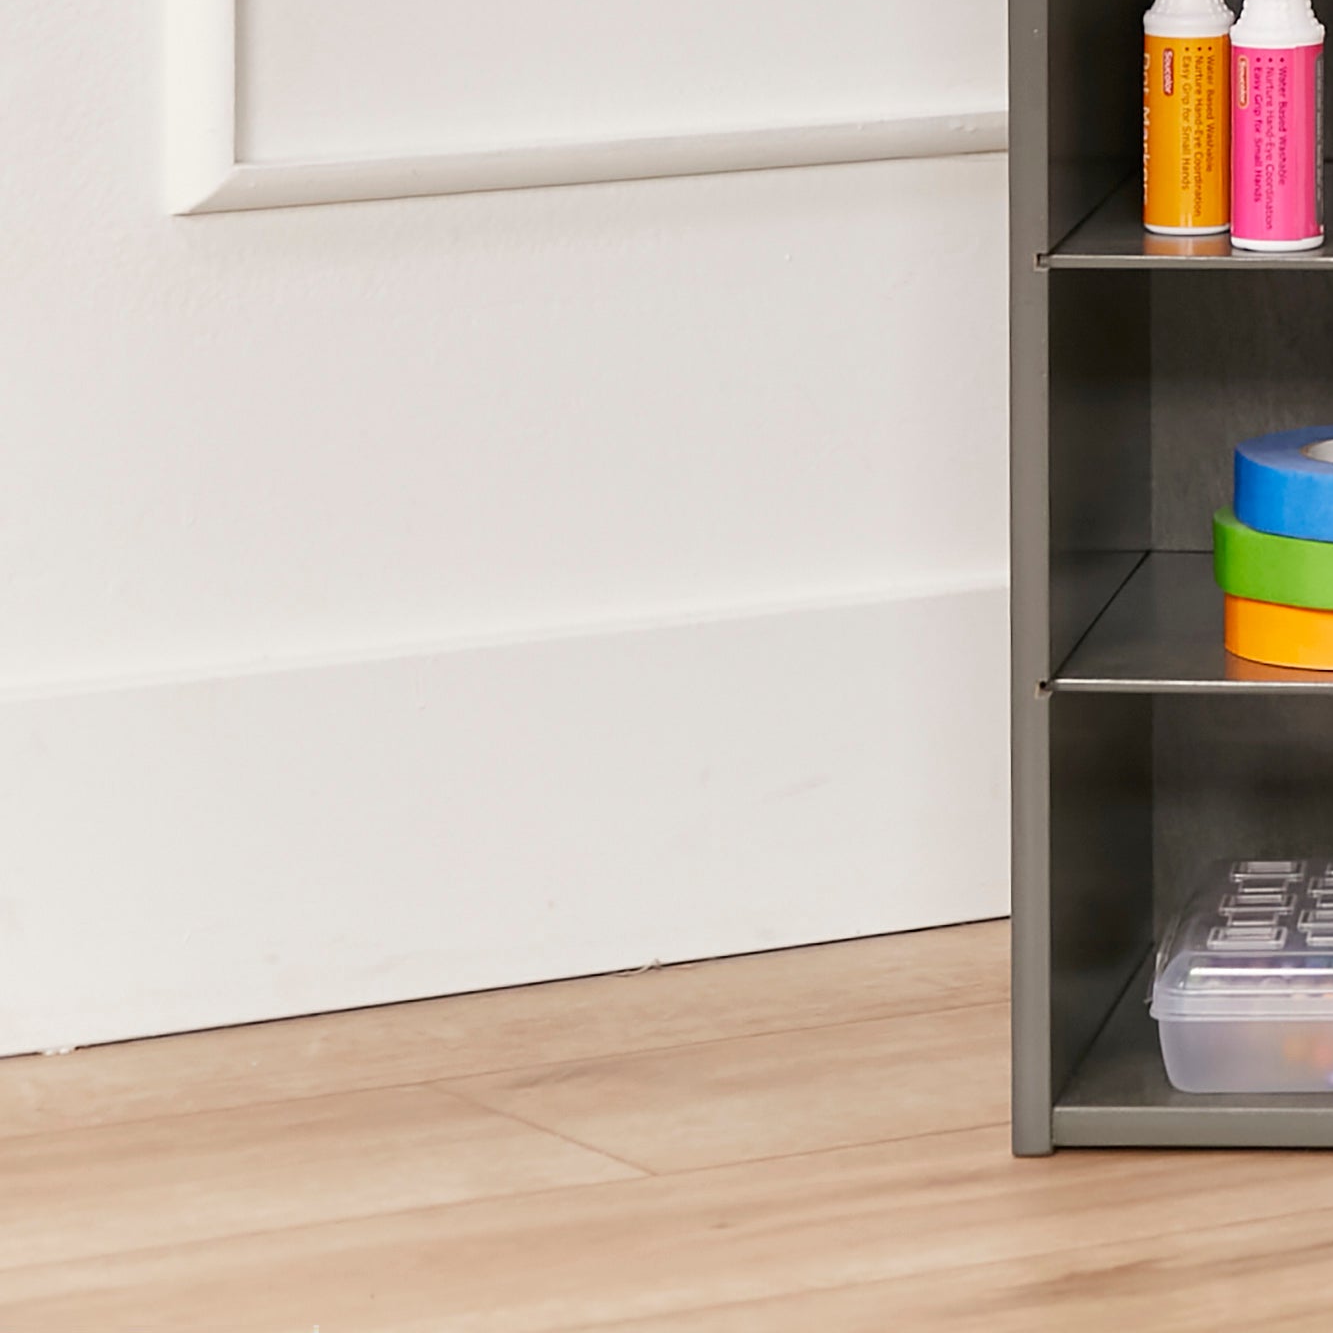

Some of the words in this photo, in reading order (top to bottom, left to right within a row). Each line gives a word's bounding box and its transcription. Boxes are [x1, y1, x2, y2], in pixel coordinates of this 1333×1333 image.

[1181, 56, 1192, 79] Easy
[1194, 55, 1204, 95] Nurture
[1206, 55, 1215, 85] Water
[1278, 66, 1287, 98] Water
[1265, 66, 1275, 107] Nurture
[1182, 108, 1192, 122] for
[1206, 89, 1215, 120] Based
[1278, 101, 1287, 132] Based
[1193, 98, 1204, 149] Hand-Eye
[1265, 110, 1275, 161] Hand-Eye
[1182, 126, 1192, 155] Small
[1254, 137, 1263, 167] Small
[1182, 158, 1192, 191] Hands
[1194, 152, 1204, 218] Coordination
[1254, 170, 1263, 203] Hands
[1265, 164, 1275, 230] Coordination
